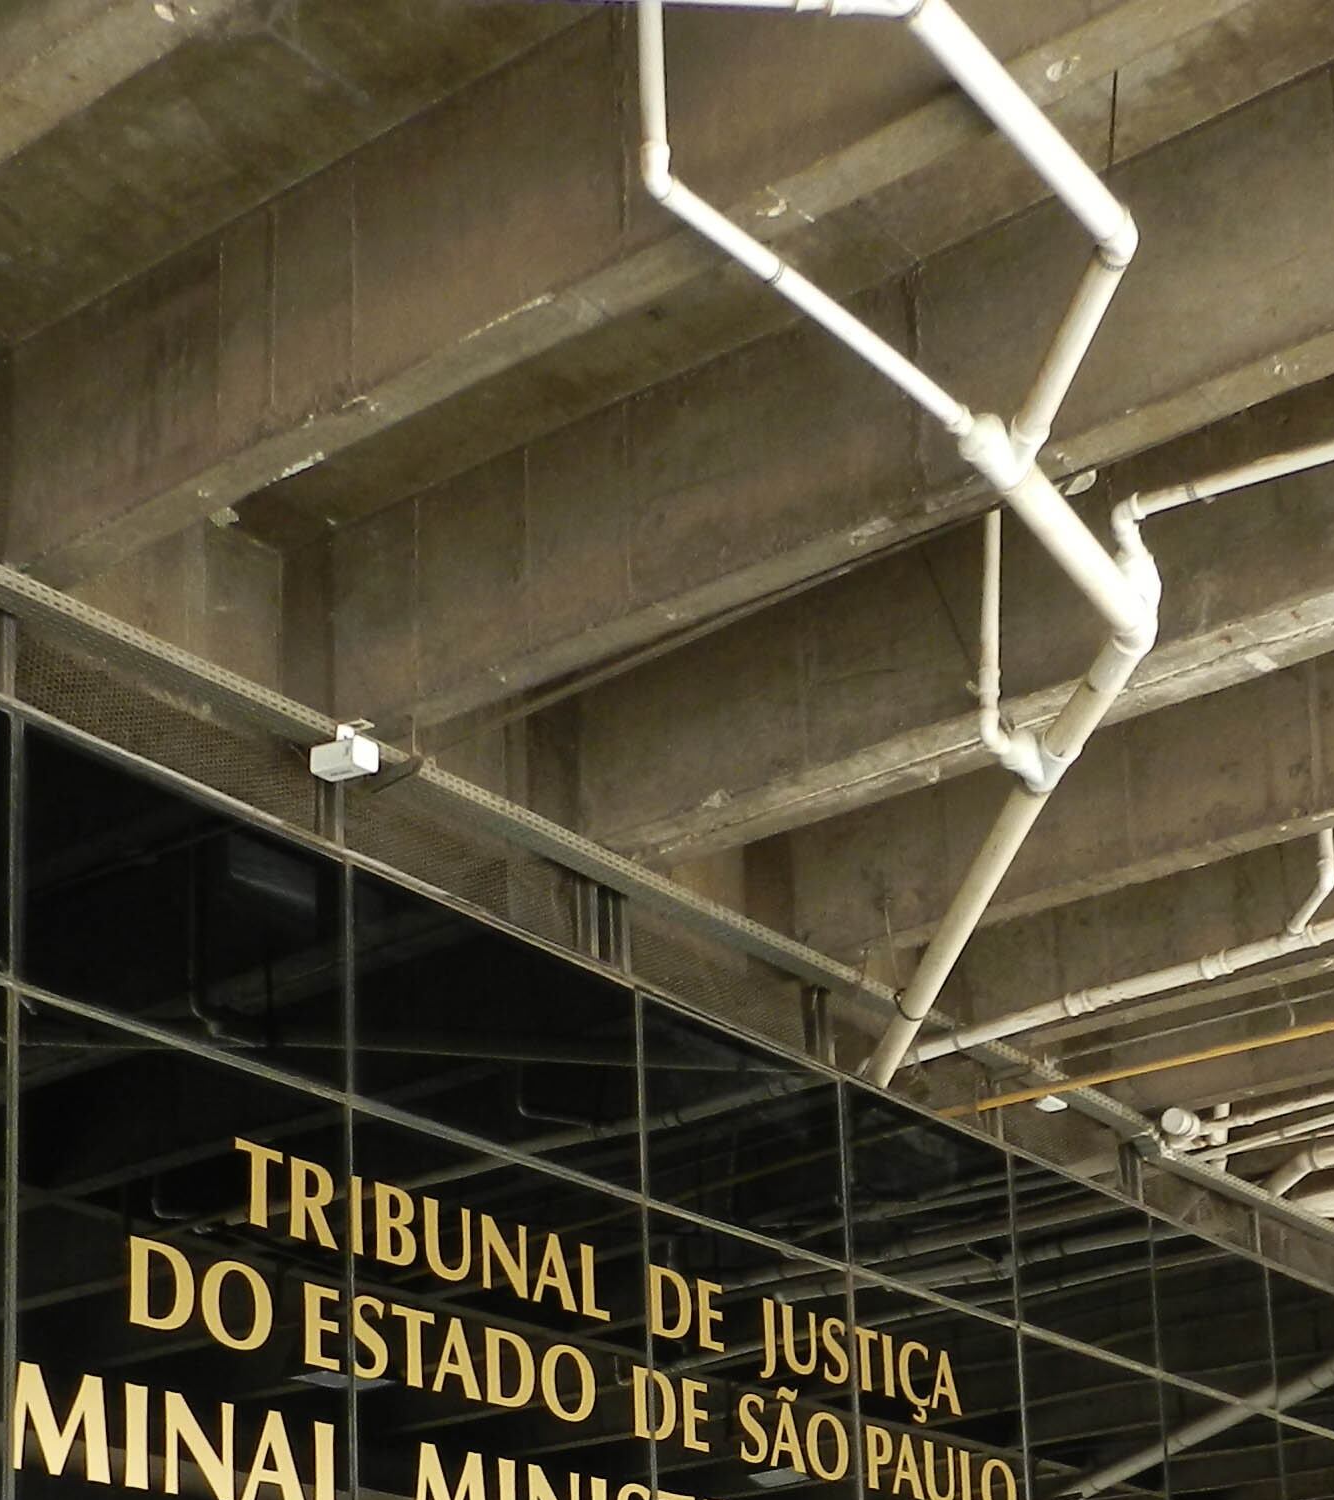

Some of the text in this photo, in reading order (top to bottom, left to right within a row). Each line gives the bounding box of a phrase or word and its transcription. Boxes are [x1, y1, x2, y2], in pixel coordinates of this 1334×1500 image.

[129, 1236, 273, 1351] DO
[303, 1282, 596, 1422] ESTADO
[632, 1365, 710, 1453] DE
[738, 1386, 849, 1481] SÃO
[234, 1137, 962, 1424] TRIBUNAL DE JUSTIÇA
